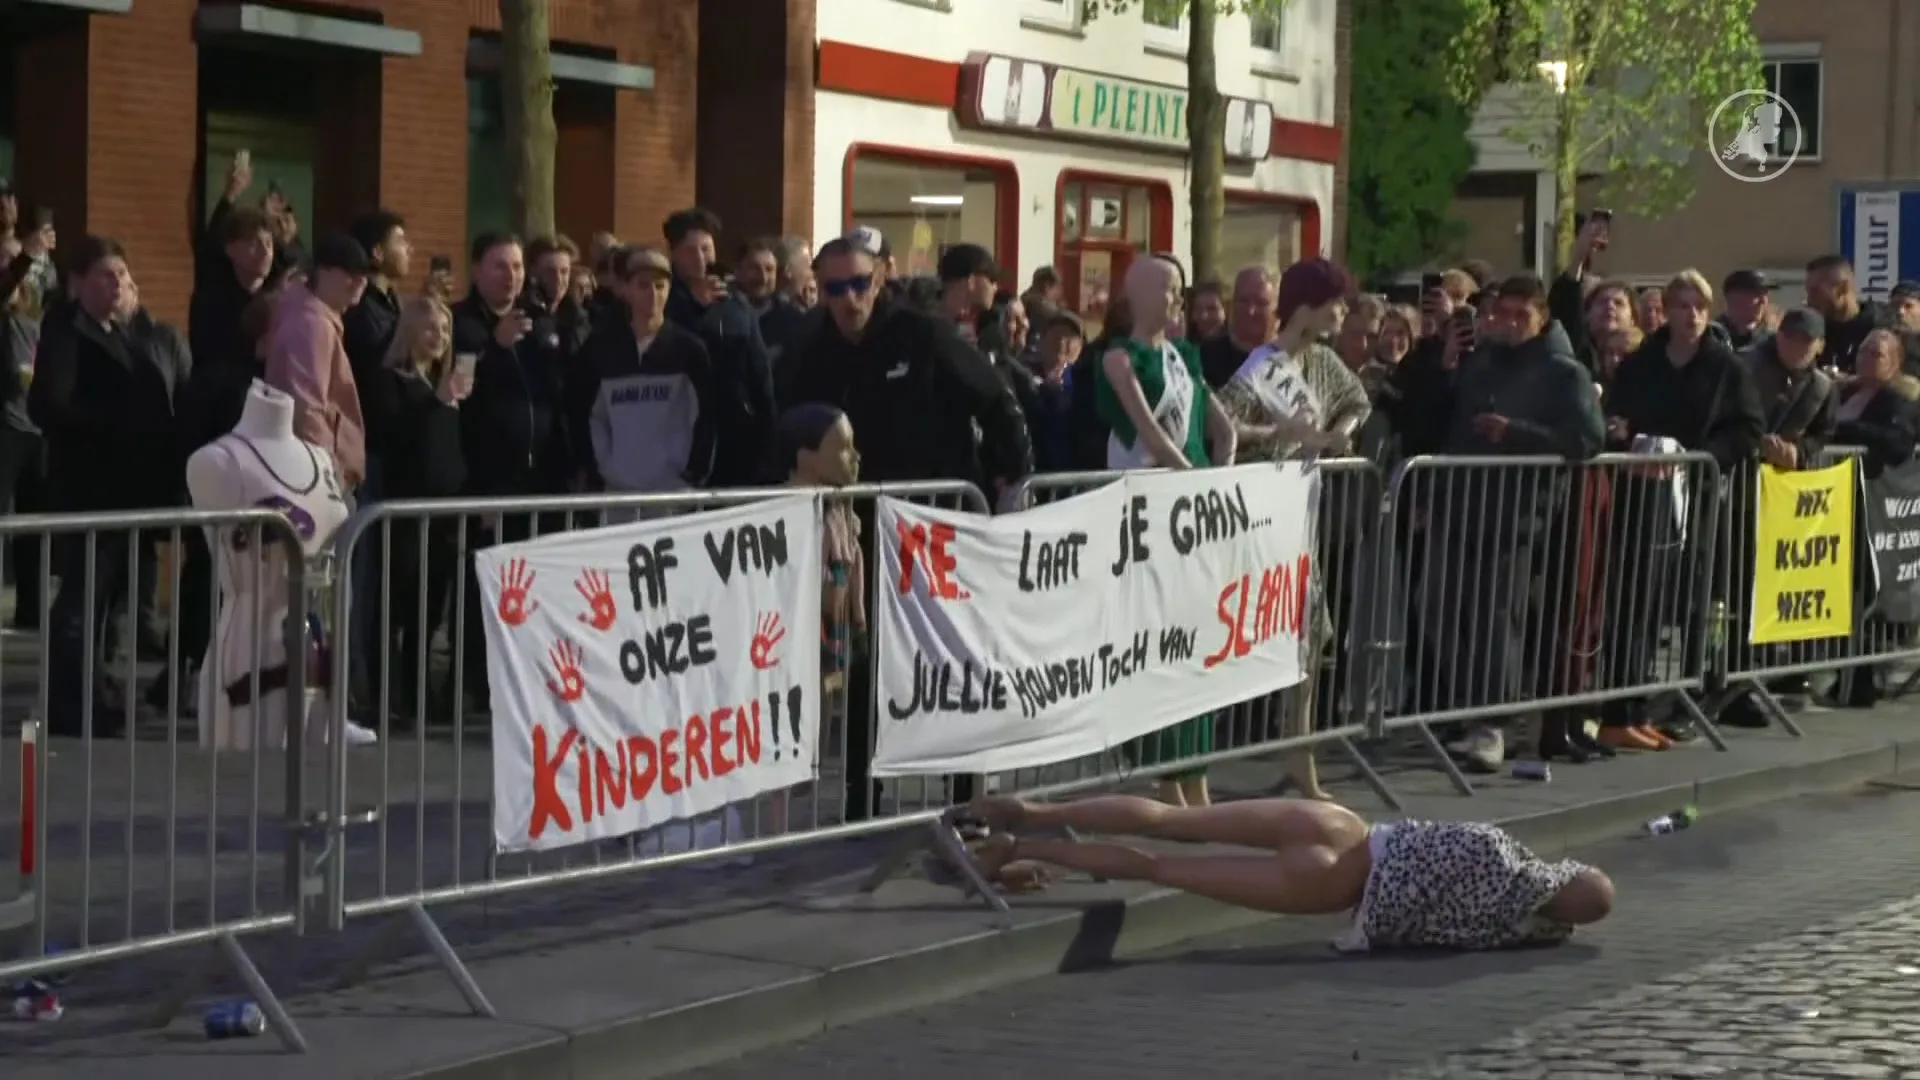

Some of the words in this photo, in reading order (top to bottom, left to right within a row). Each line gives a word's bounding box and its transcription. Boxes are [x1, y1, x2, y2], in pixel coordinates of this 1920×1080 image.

[1091, 80, 1187, 140] PLEINT
[627, 536, 677, 612] AF
[704, 518, 788, 585] VAN
[1018, 529, 1087, 592] LAAT
[1777, 588, 1832, 622] NIET.
[619, 613, 716, 685] ONZE
[889, 650, 1007, 720] JULLIE
[1006, 652, 1095, 720] HOUDEN
[1159, 624, 1198, 664] VAN
